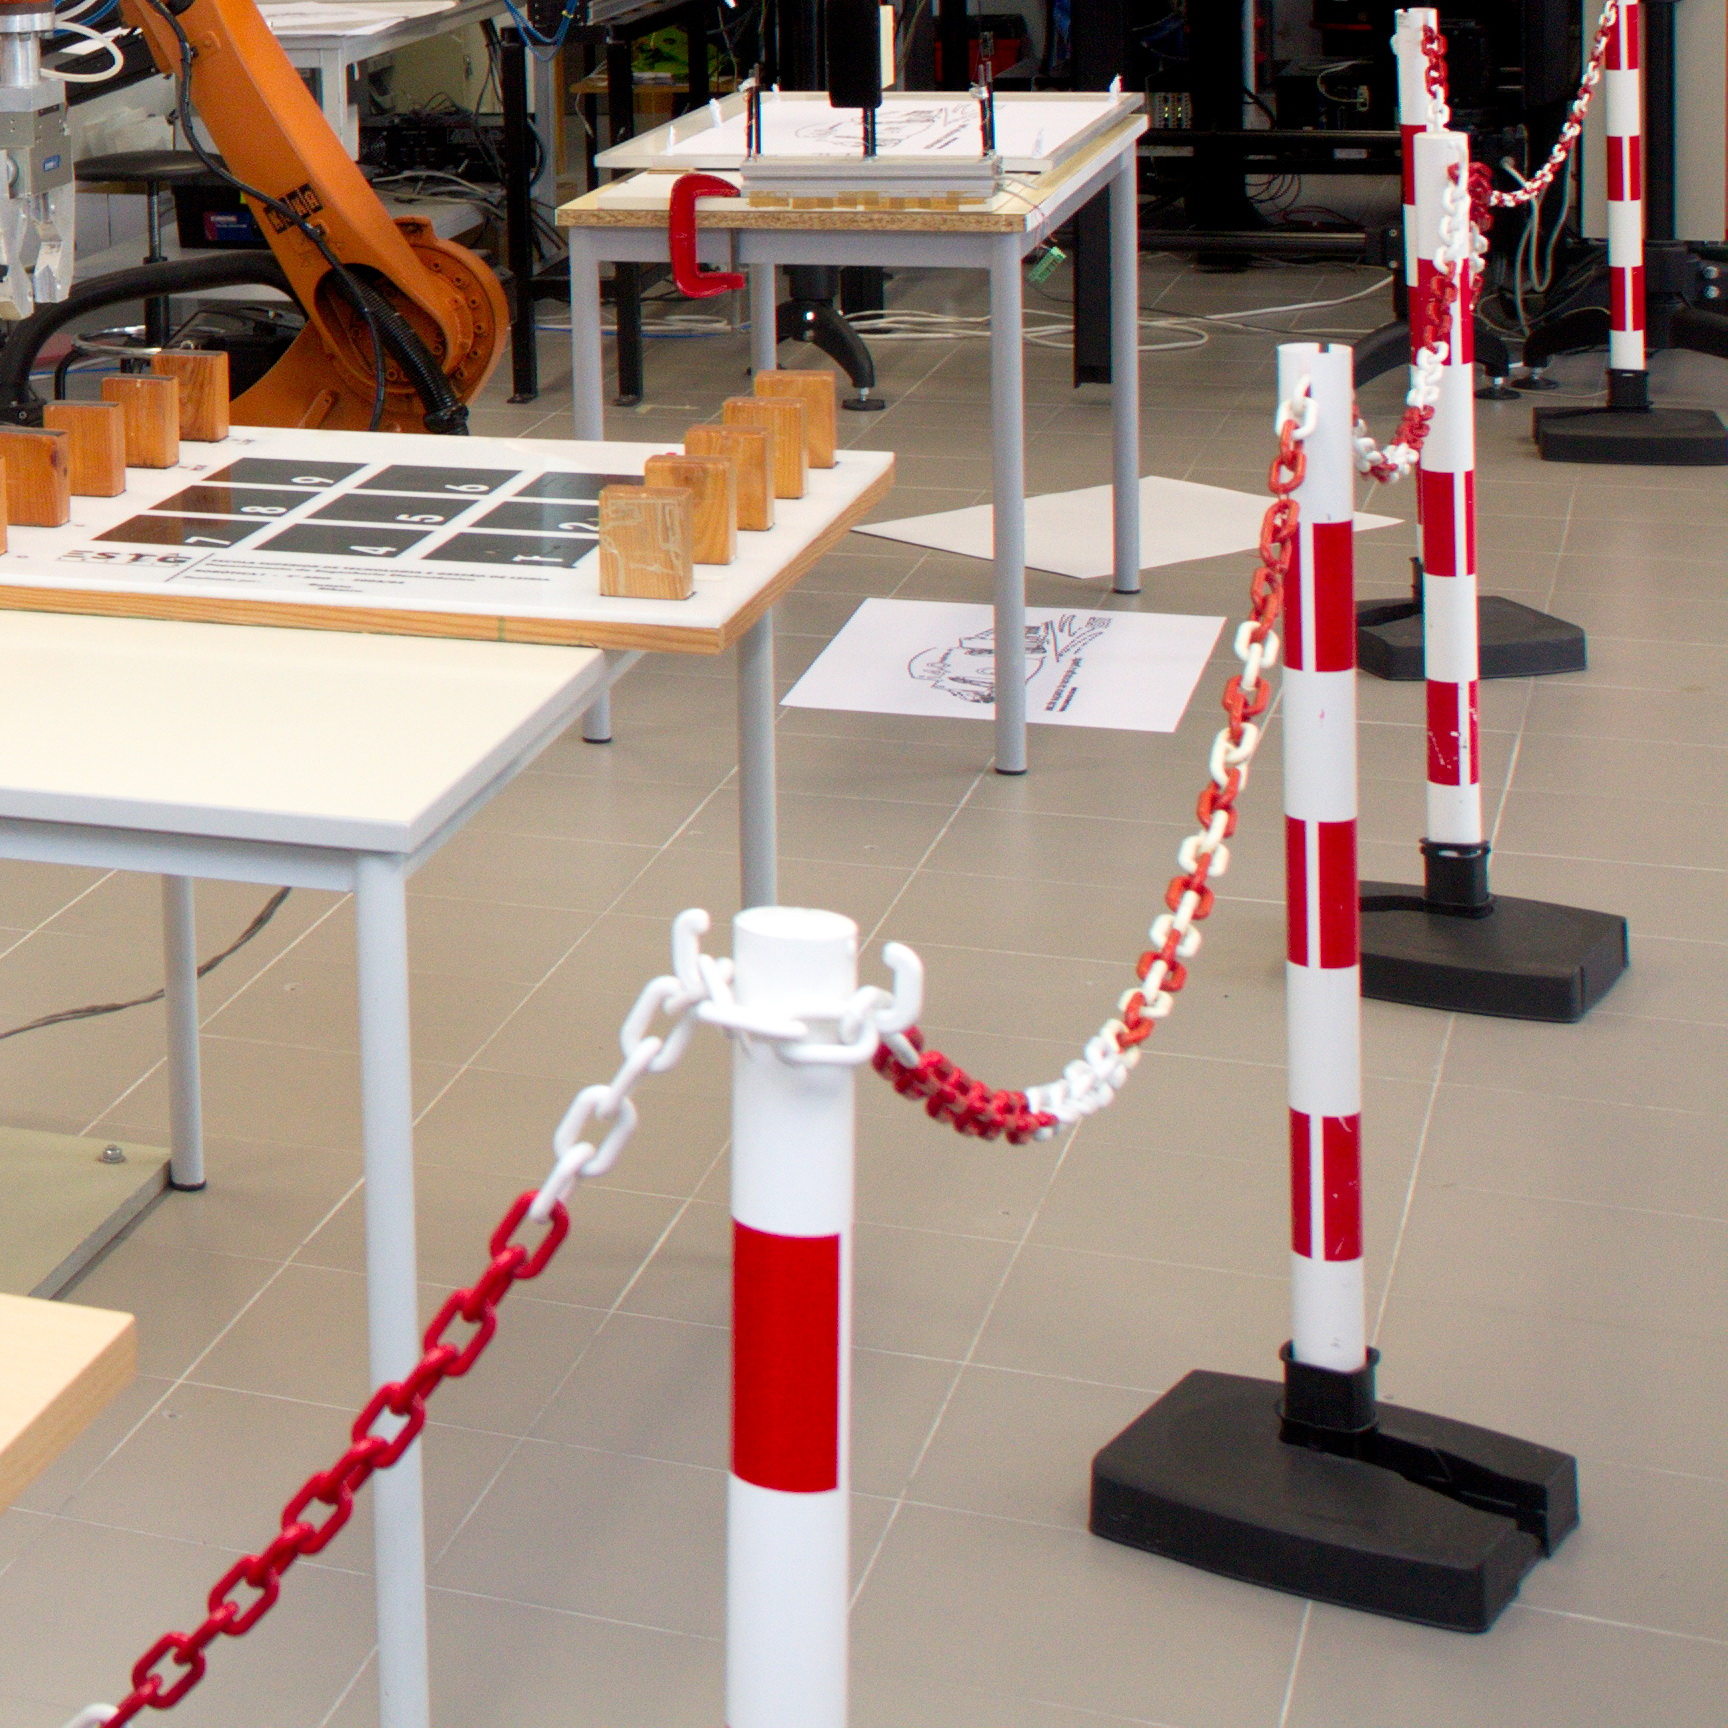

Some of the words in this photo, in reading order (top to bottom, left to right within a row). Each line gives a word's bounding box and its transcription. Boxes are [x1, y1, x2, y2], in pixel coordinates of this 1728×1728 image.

[290, 475, 335, 487] 9
[445, 482, 491, 493] 6
[240, 504, 288, 516] 8
[395, 512, 446, 524] 5
[558, 516, 600, 532] 2
[184, 534, 232, 548] 7
[348, 542, 399, 556] 4
[511, 552, 565, 563] 1
